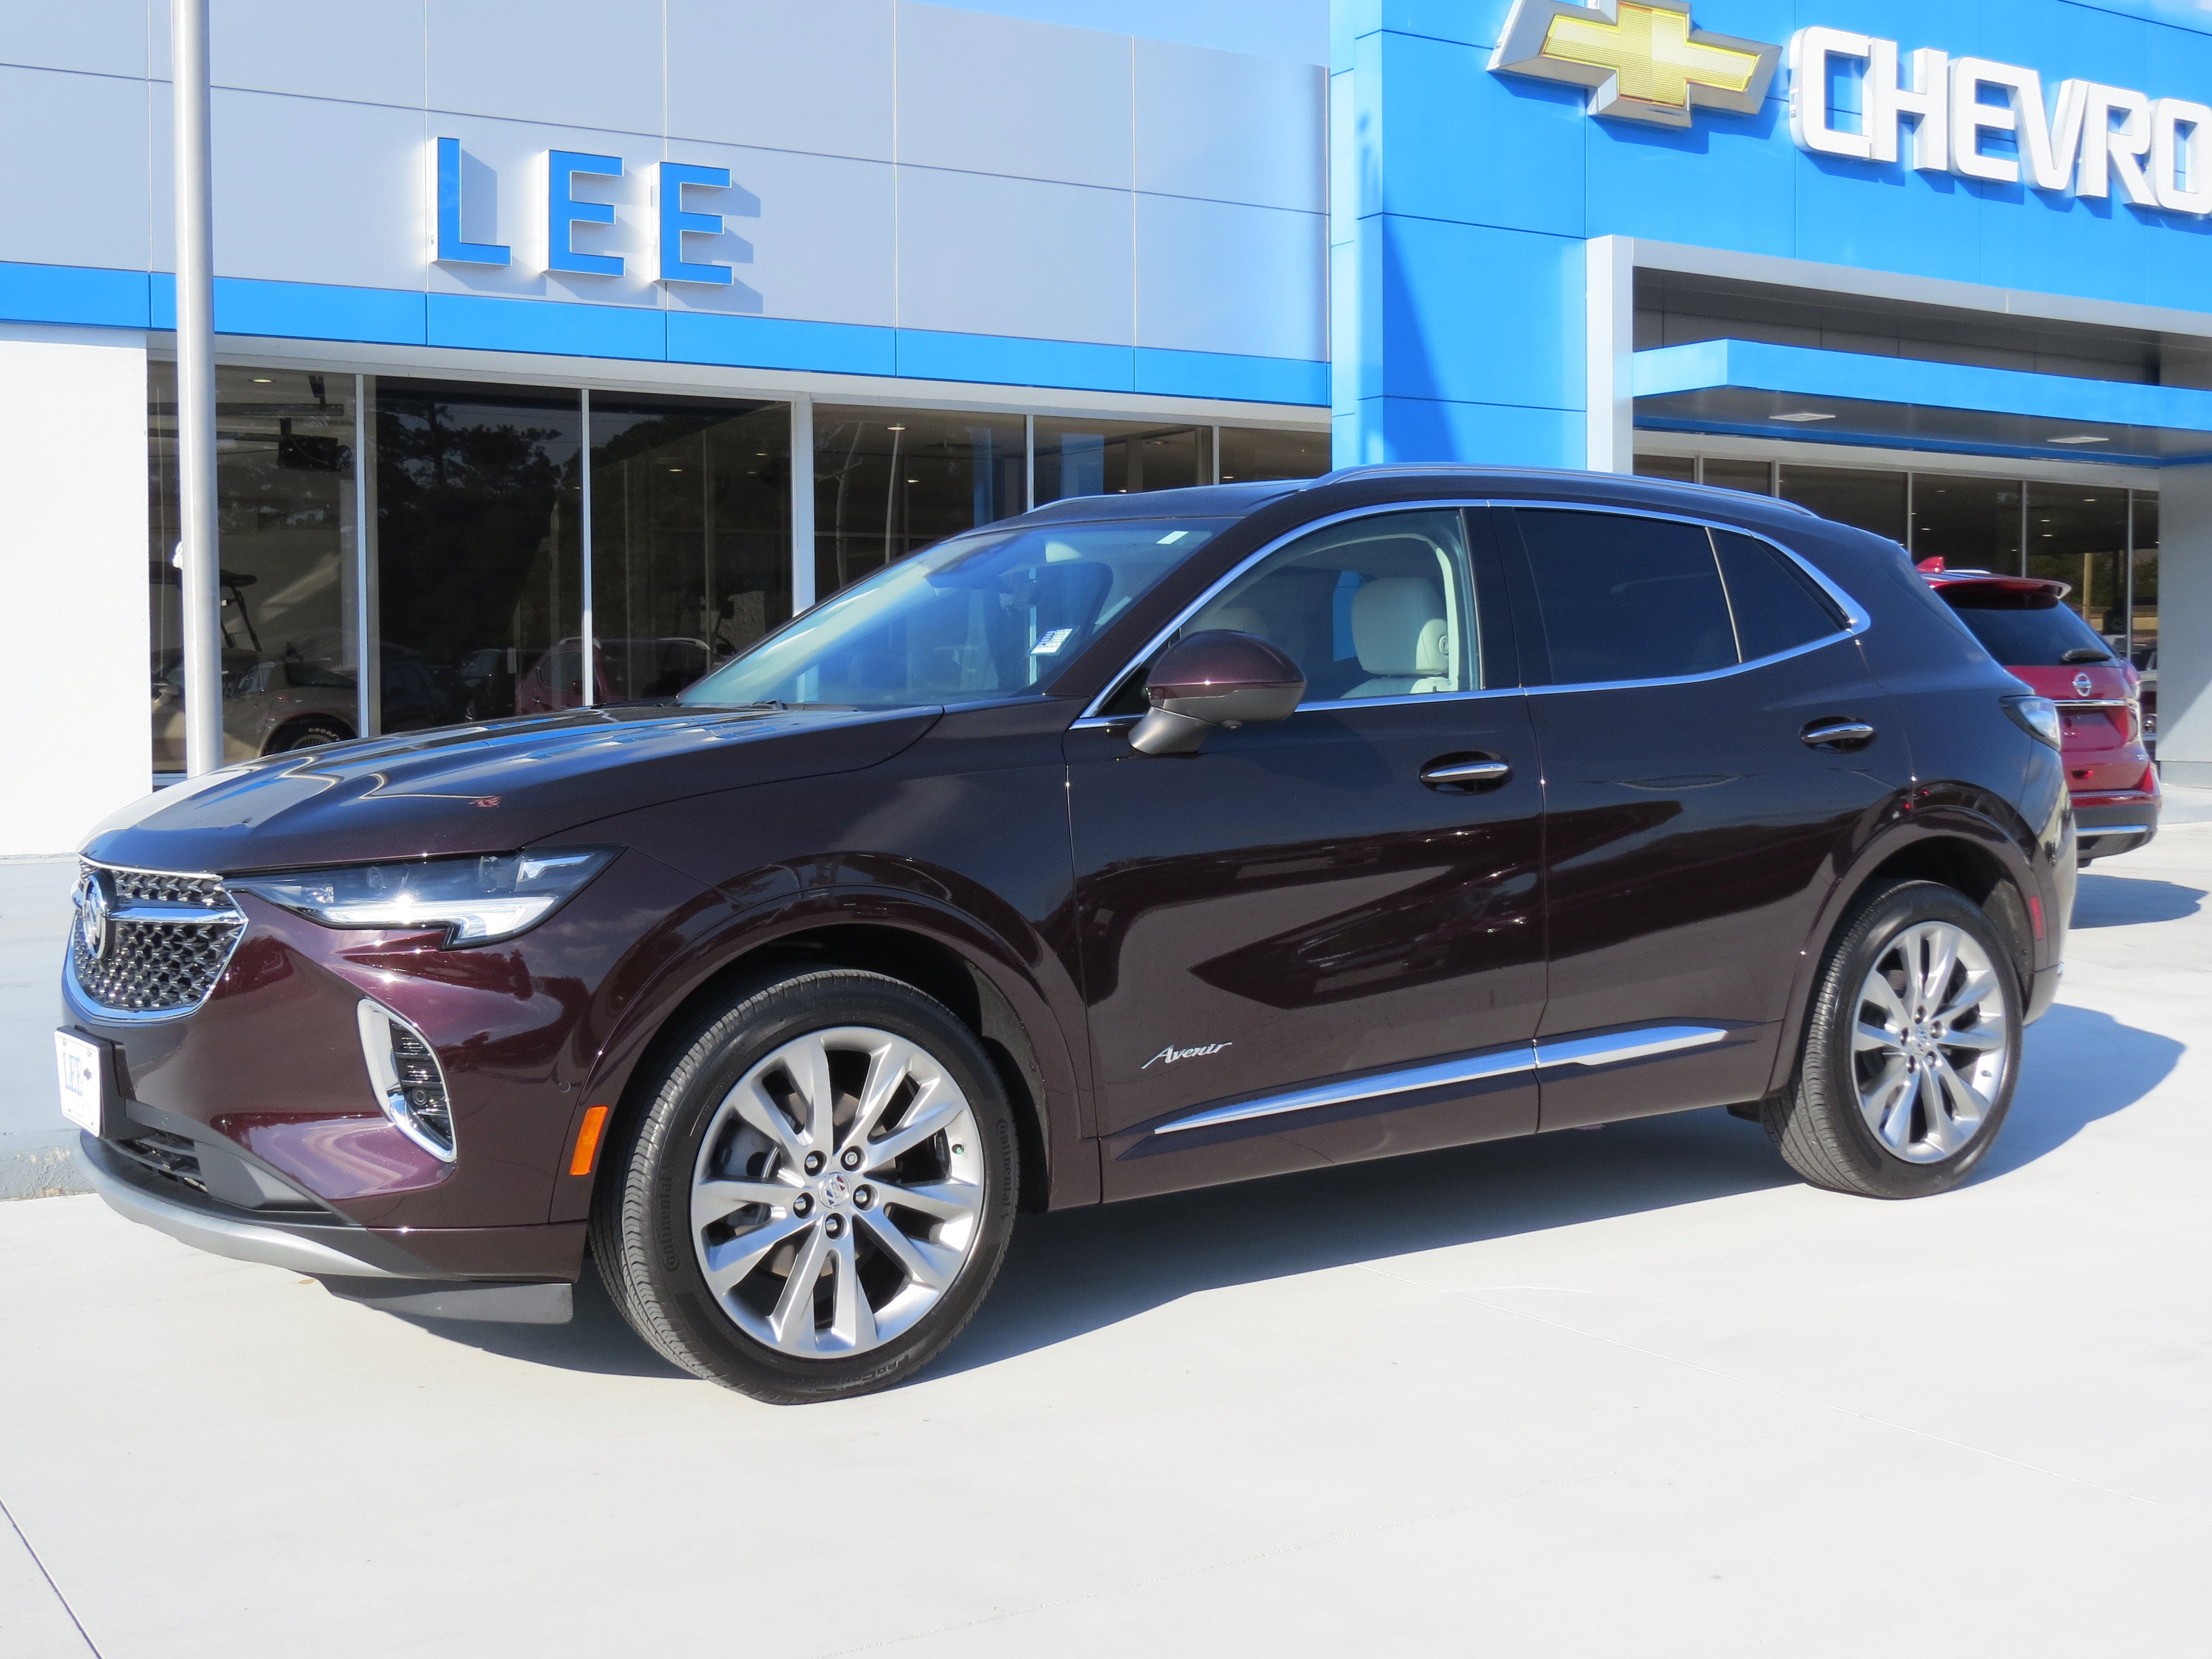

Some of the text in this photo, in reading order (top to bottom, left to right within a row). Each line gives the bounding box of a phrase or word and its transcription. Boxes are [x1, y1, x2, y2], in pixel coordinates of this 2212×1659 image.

[1788, 25, 2212, 214] CHEVRO
[431, 137, 734, 286] LEE
[62, 1052, 83, 1097] LEE
[1140, 1042, 1233, 1070] Avenir
[996, 1118, 1013, 1208] Continental
[657, 1176, 680, 1273] Continental
